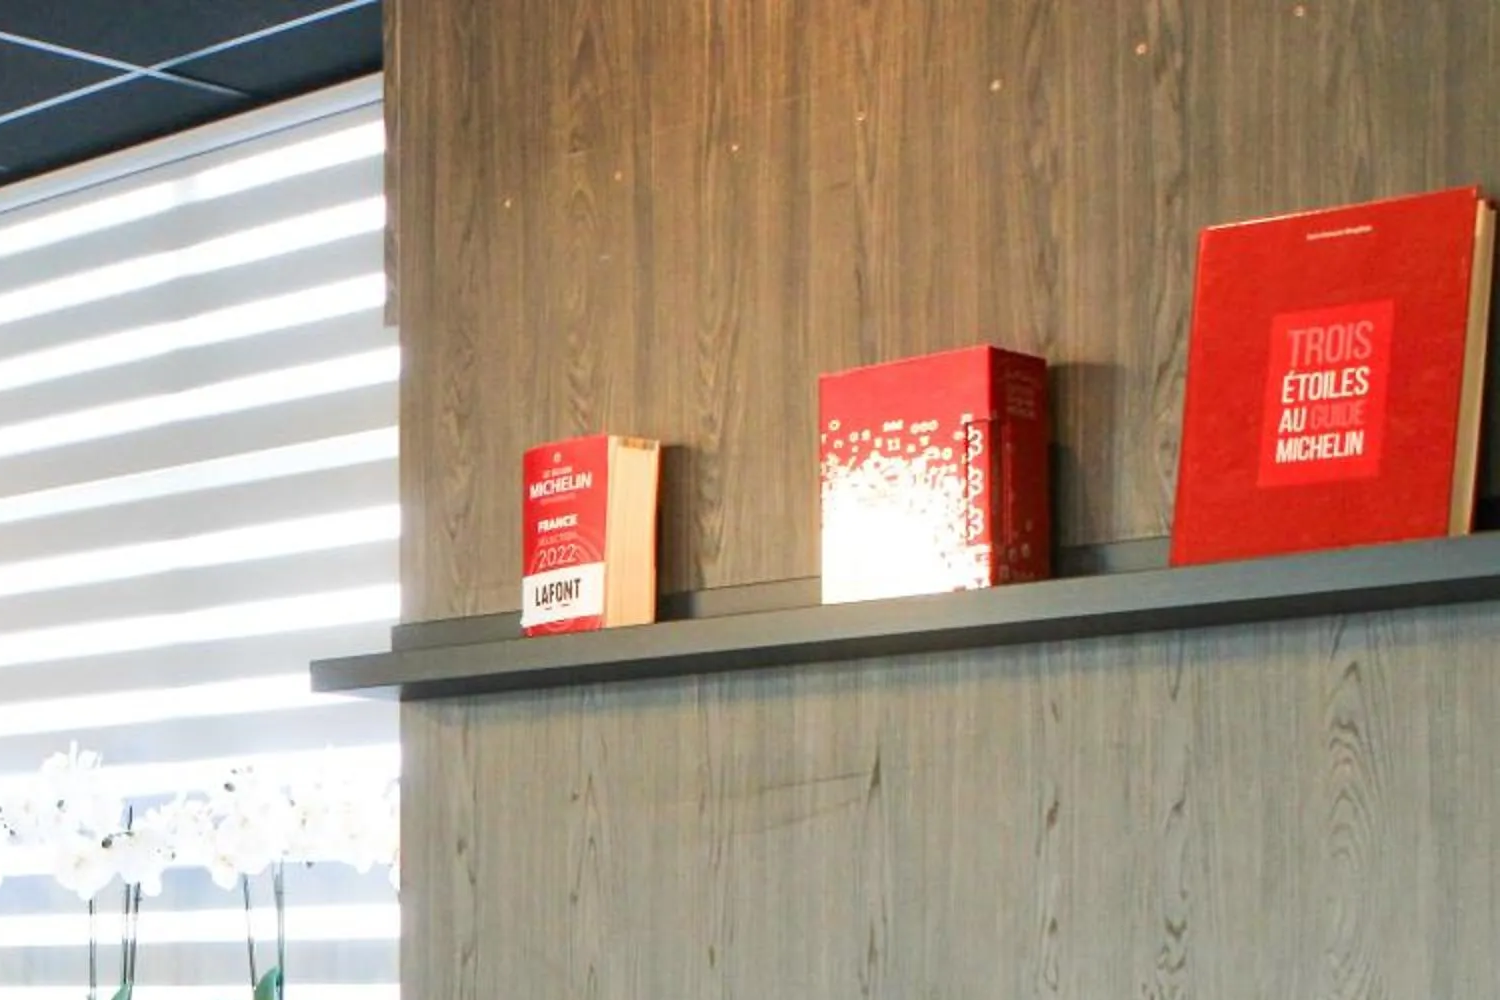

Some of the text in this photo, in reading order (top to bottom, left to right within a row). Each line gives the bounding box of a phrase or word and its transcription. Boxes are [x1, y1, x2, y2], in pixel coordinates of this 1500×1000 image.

[1286, 320, 1374, 367] TROIS
[1281, 366, 1370, 404] ÉTOILES
[1278, 400, 1366, 433] AU GUIDE
[1275, 431, 1365, 464] MICHELIN
[529, 472, 593, 499] MICHELIN
[537, 514, 578, 533] FRANCE
[538, 544, 577, 569] 2022
[535, 578, 581, 606] LAFONT
